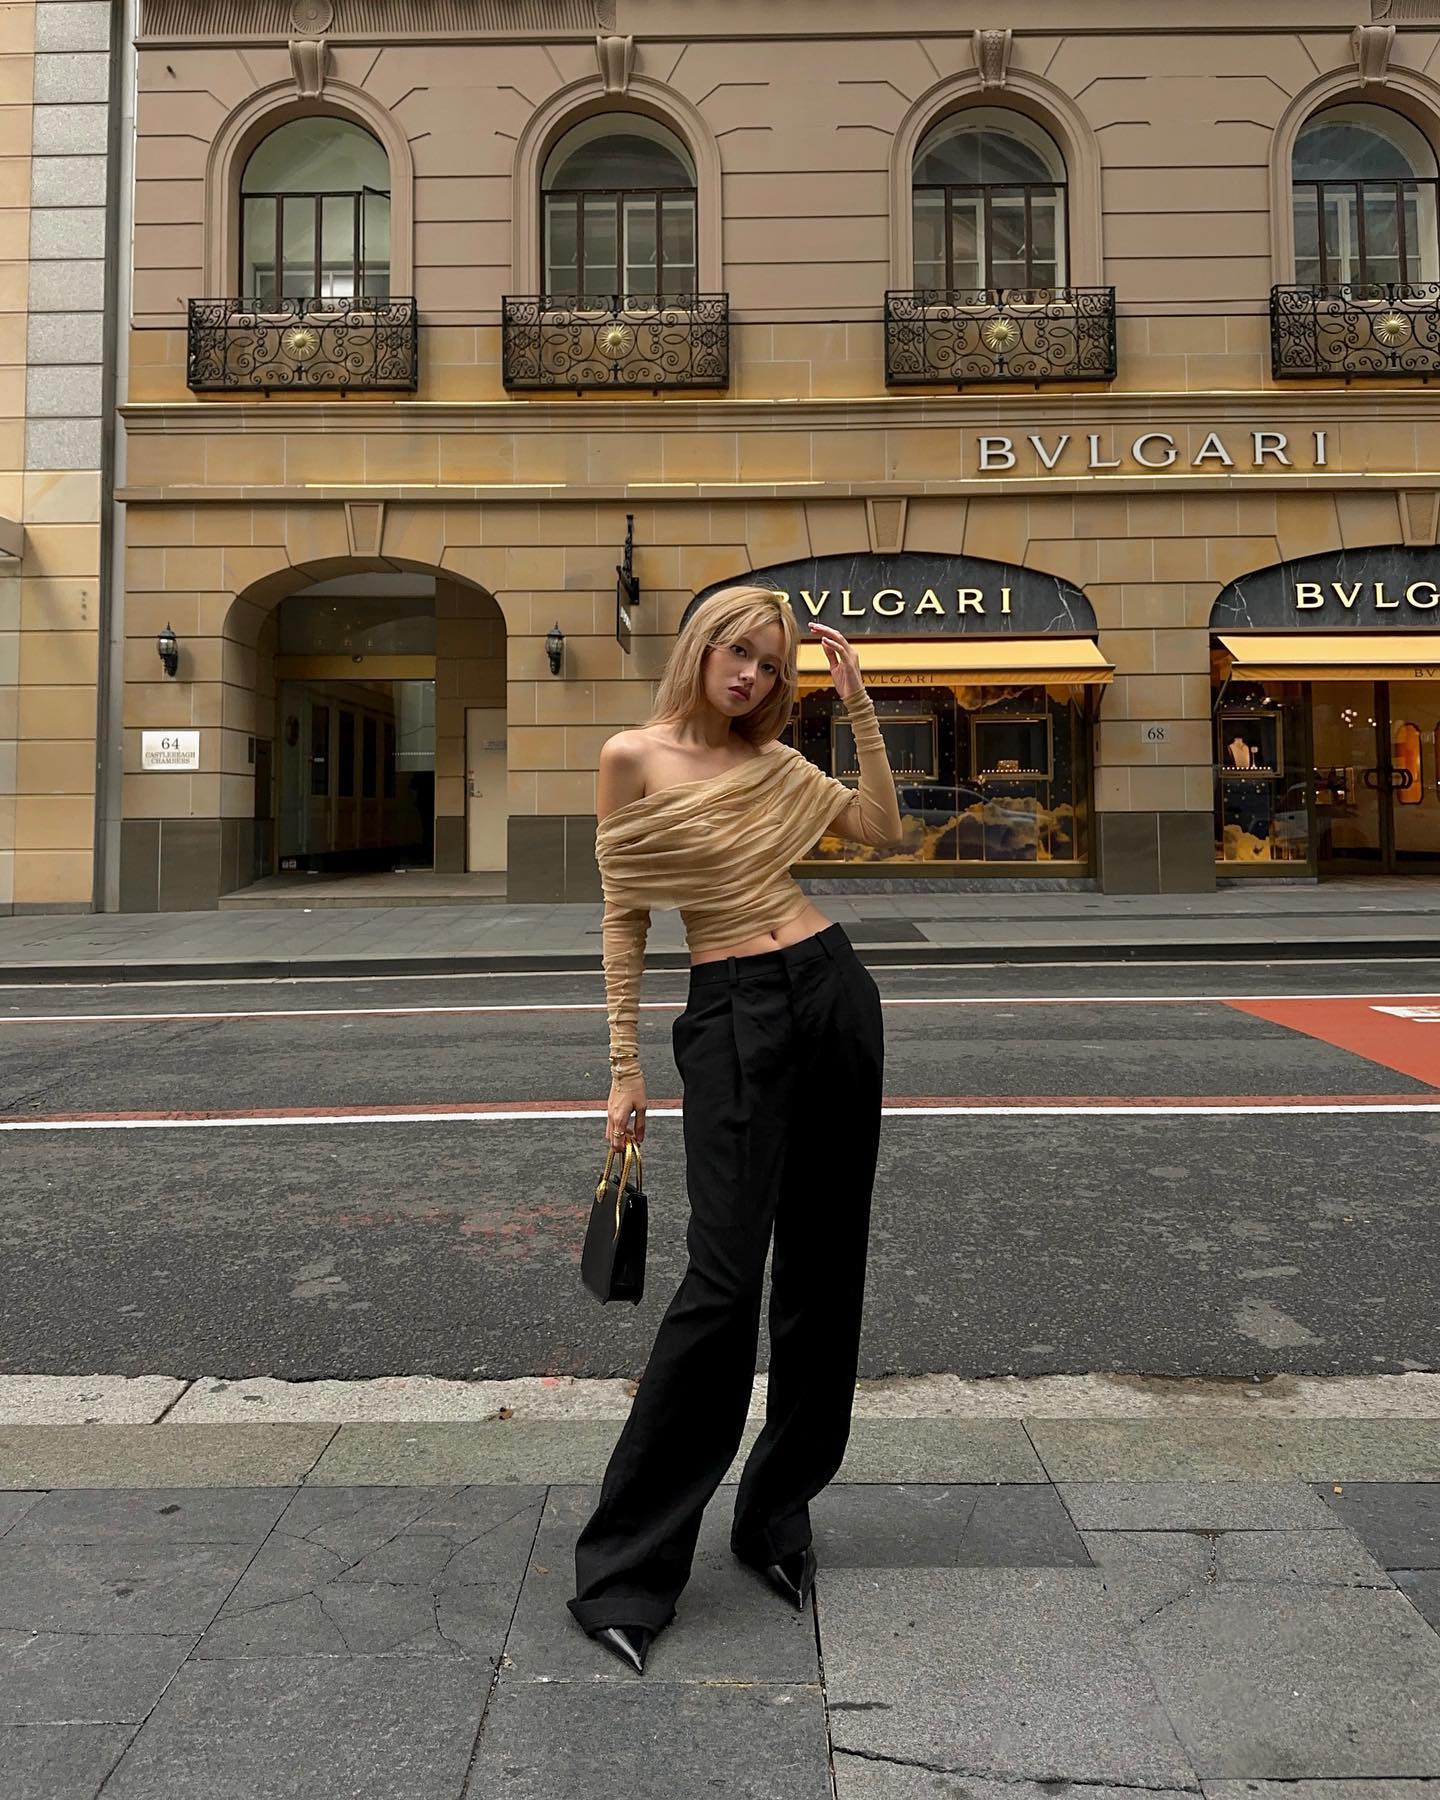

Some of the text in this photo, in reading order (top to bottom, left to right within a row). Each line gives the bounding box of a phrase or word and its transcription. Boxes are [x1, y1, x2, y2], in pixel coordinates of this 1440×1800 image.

[977, 431, 1328, 471] BVLGARI
[1295, 581, 1440, 609] BVLG
[861, 674, 934, 684] VLGARI
[1147, 727, 1164, 740] 68
[161, 737, 179, 750] 64
